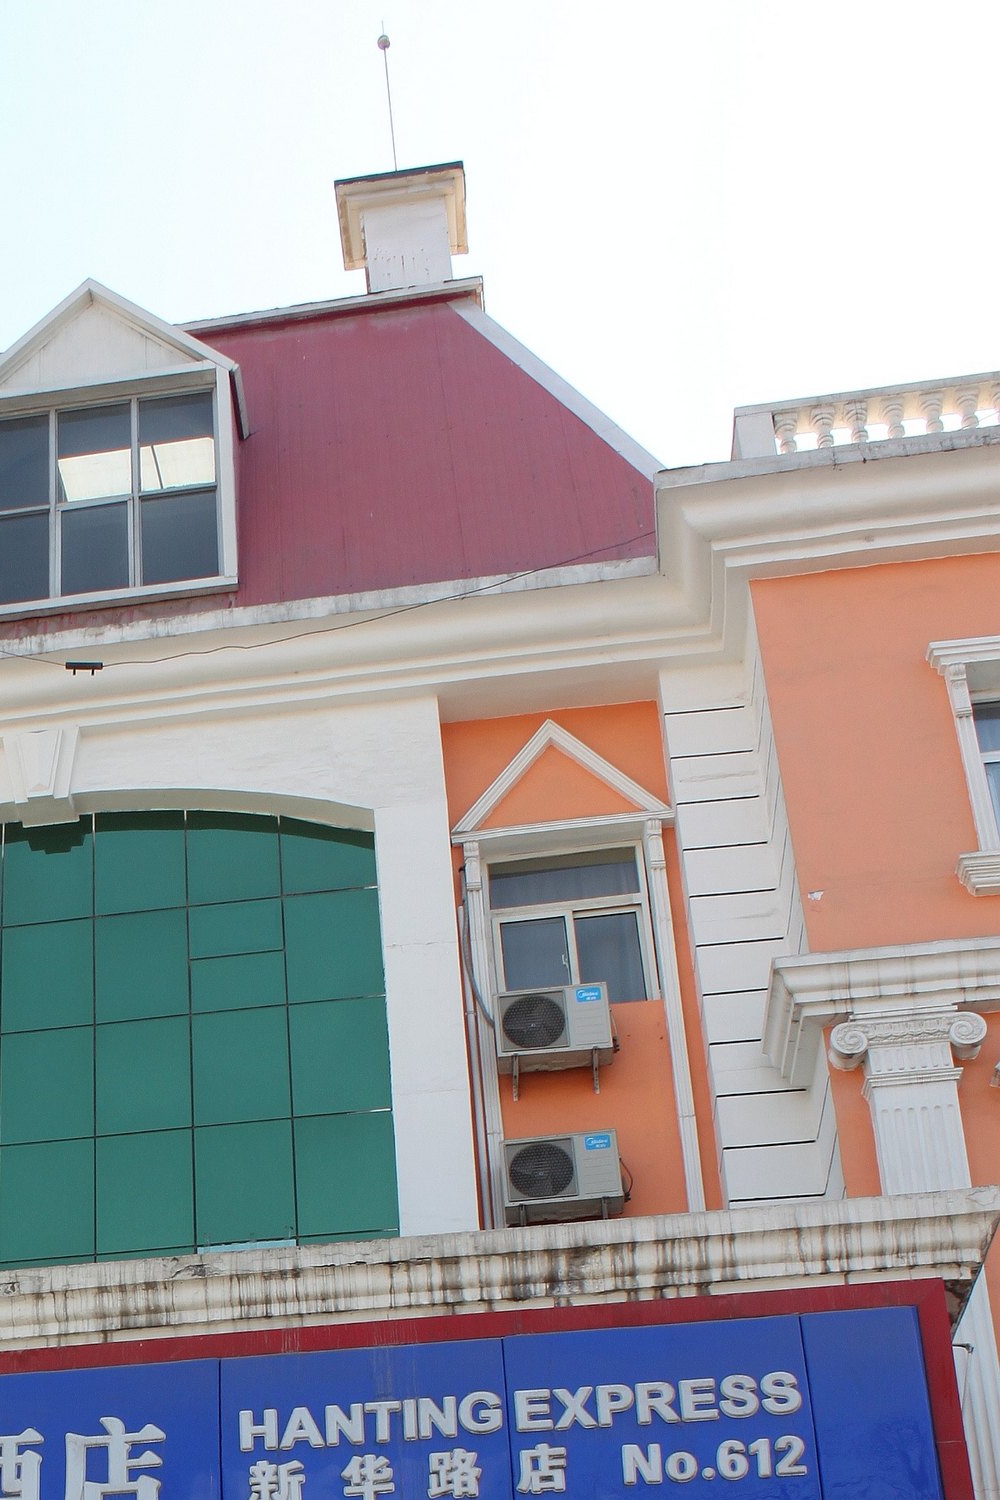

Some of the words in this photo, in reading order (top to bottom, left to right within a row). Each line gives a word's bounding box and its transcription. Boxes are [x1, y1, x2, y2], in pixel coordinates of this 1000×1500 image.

[239, 1391, 502, 1452] HANTING
[513, 1371, 802, 1433] EXPRESS
[622, 1435, 808, 1486] No.612
